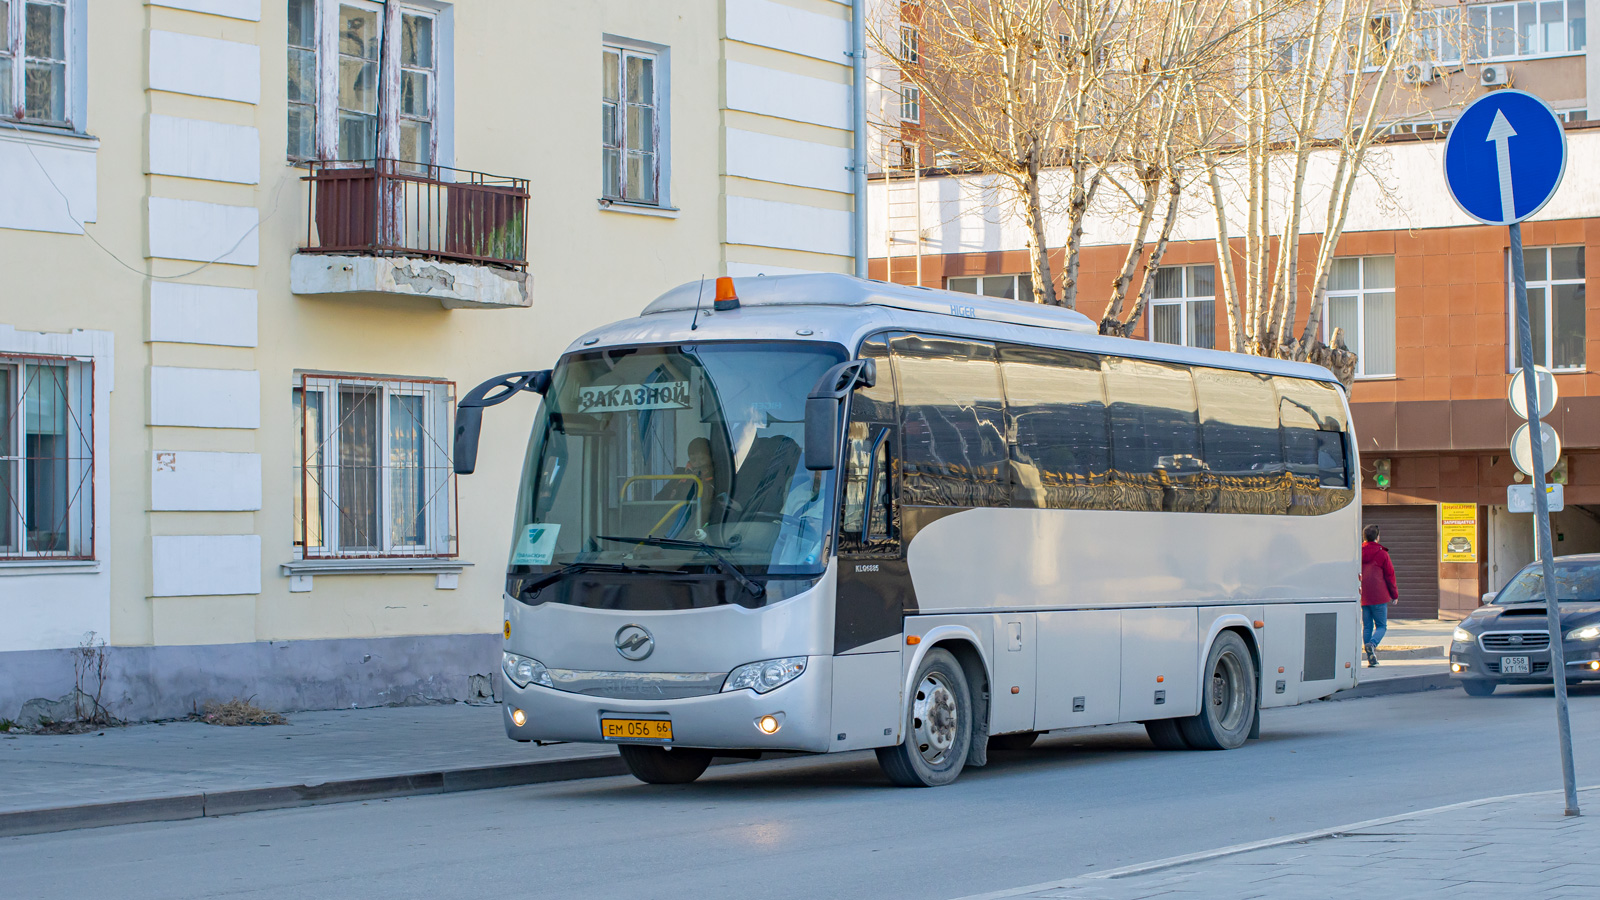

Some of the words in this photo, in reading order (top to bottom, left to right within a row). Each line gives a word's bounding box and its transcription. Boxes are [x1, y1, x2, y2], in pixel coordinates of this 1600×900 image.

[950, 304, 976, 318] HIGER
[582, 382, 685, 407] ЗАКАЗНОЙ
[1512, 657, 1525, 665] 558
[628, 722, 650, 736] 056
[656, 722, 668, 733] 66
